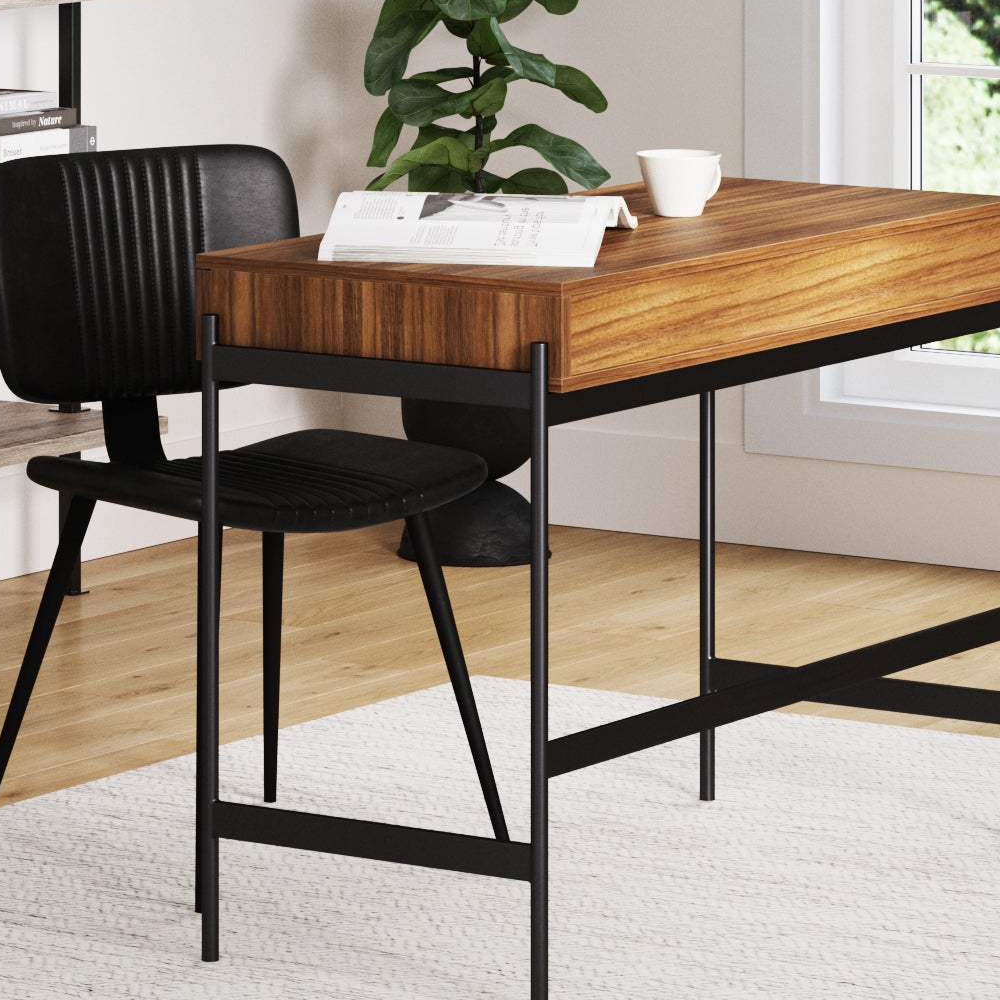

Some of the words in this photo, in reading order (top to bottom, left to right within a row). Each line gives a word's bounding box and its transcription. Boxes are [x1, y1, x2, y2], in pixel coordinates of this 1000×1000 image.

[12, 118, 31, 129] Inspired
[32, 118, 37, 128] by
[38, 116, 63, 127] Nature
[2, 147, 22, 158] Breuer
